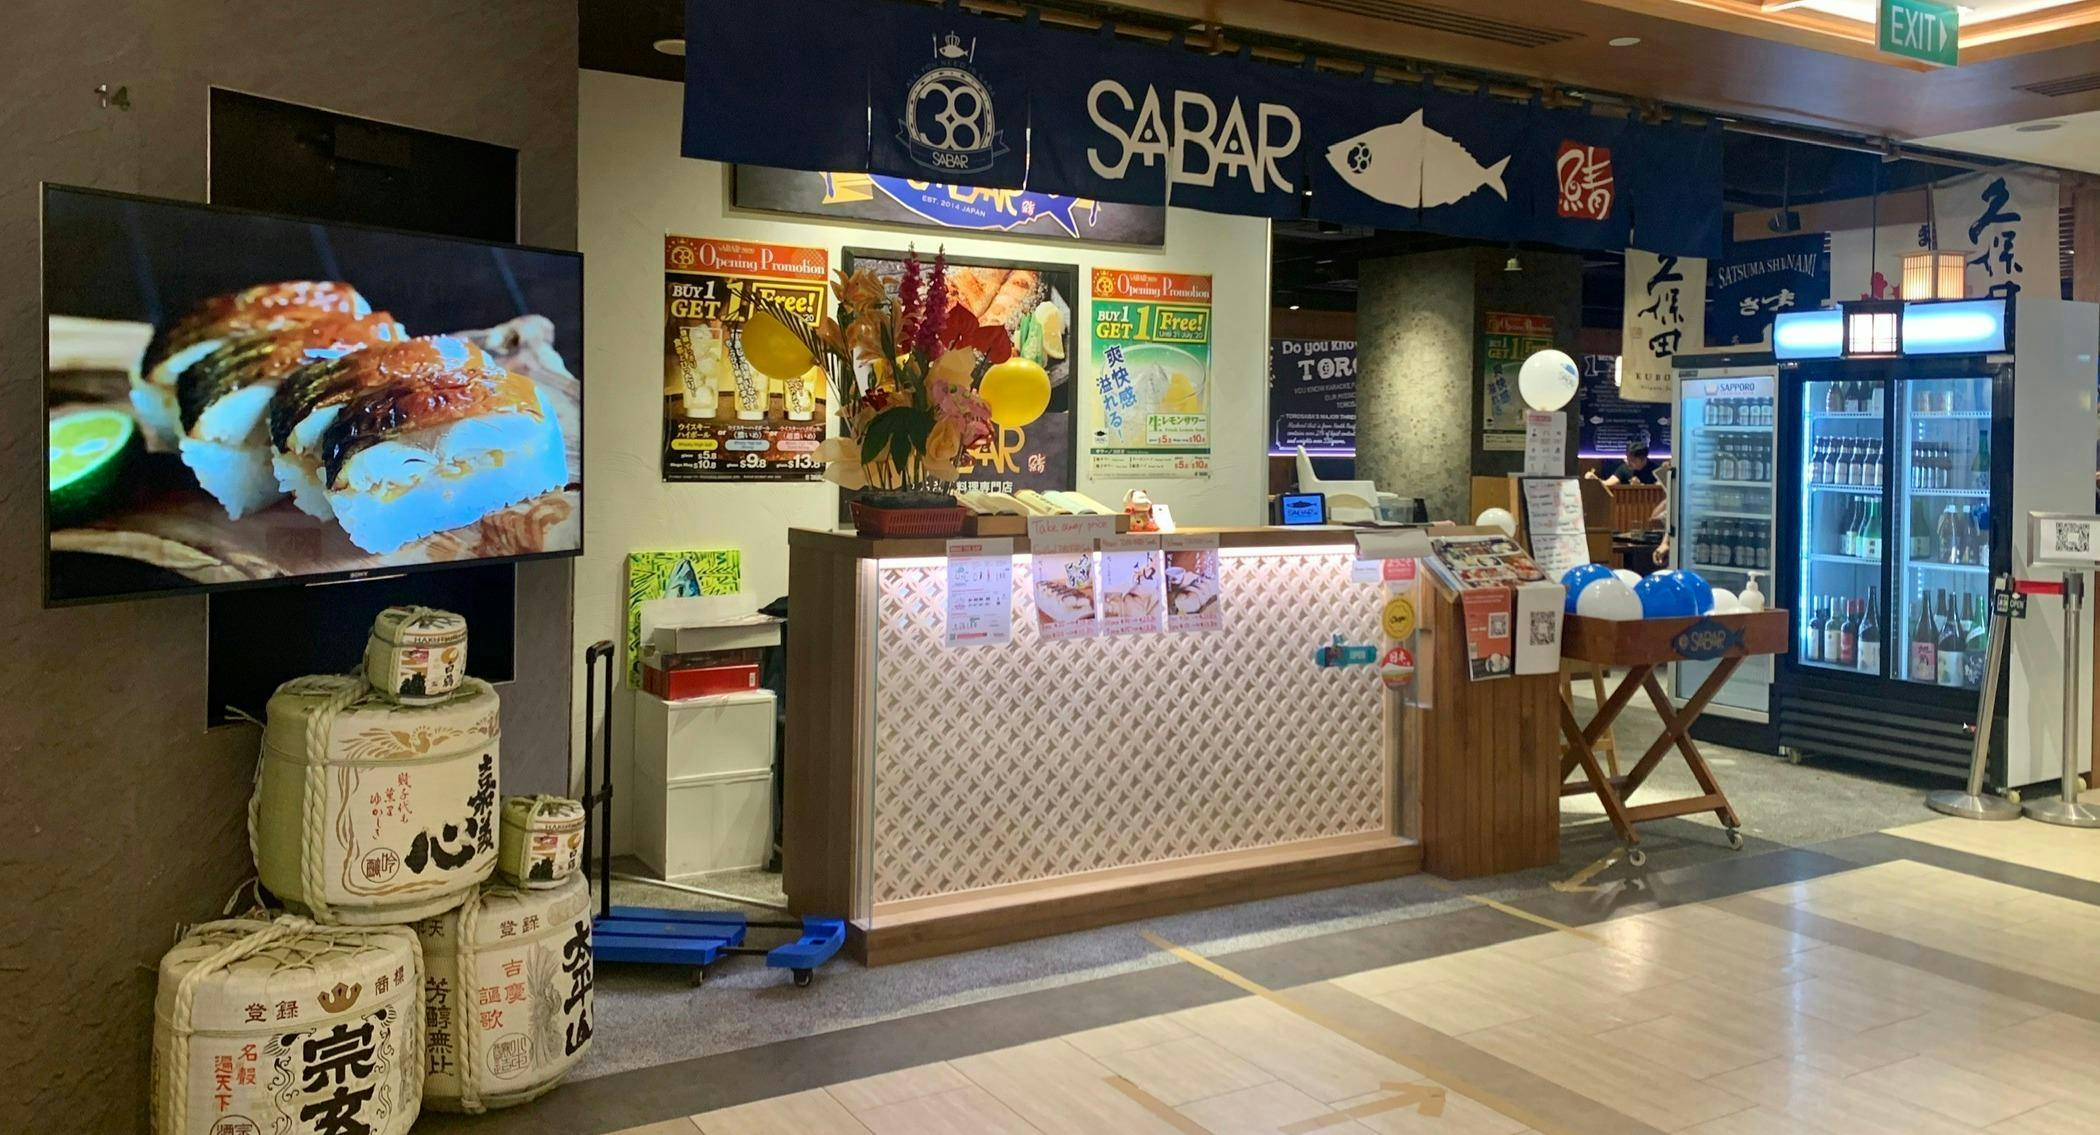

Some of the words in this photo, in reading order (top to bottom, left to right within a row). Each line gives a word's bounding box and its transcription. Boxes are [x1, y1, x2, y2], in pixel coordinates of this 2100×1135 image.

[1891, 5, 1936, 51] EXIT
[94, 84, 130, 111] 14
[917, 82, 982, 150] 38
[1086, 79, 1301, 194] SABAR
[932, 151, 969, 170] SABAR
[921, 194, 940, 205] EST.
[940, 199, 961, 211] 2014
[961, 203, 987, 217] JAPAN
[699, 242, 758, 271] Opening
[761, 248, 825, 275] Promotion
[1117, 273, 1161, 298] Opening
[1162, 276, 1210, 299] Promotion
[1718, 260, 1766, 289] SATSUMA
[671, 299, 721, 320] GET
[720, 279, 746, 322] 1
[672, 284, 704, 299] BUY
[703, 280, 716, 300] 1
[1096, 321, 1134, 339] GET
[1132, 305, 1151, 341] 1
[1159, 311, 1204, 332] Free!
[1097, 310, 1121, 321] BUY
[1120, 305, 1130, 322] 1
[1282, 341, 1302, 354] Do
[1303, 341, 1329, 355] you
[1104, 345, 1138, 410] 爽快感
[1719, 382, 1755, 392] SAPPORO
[693, 459, 717, 469] $10.8
[698, 450, 717, 460] $5.8
[740, 453, 767, 469] $9.8
[787, 453, 821, 469] $13.8
[1032, 520, 1057, 534] Take
[1061, 521, 1082, 534] away
[1086, 519, 1108, 533] price
[2009, 600, 2025, 609] OPEN
[1690, 629, 1727, 651] SABAR
[499, 914, 540, 939] 登録
[244, 1000, 299, 1024] 登録
[374, 965, 405, 996] 商標
[425, 976, 454, 1077] 芳醇無比
